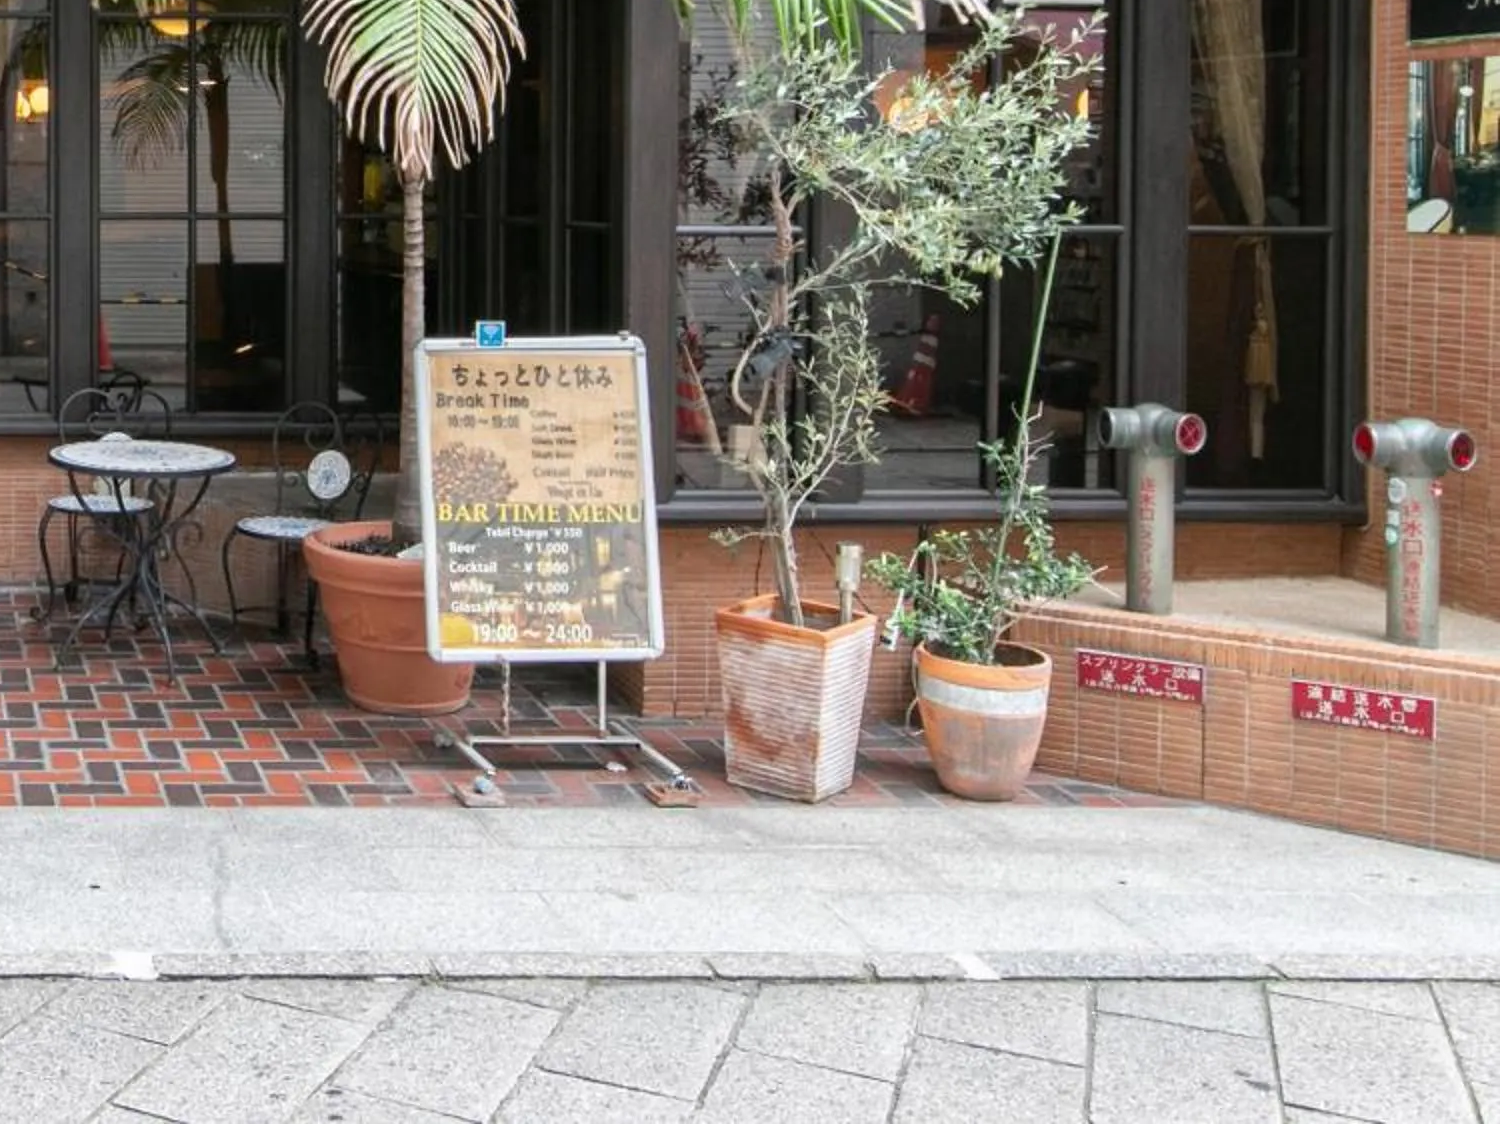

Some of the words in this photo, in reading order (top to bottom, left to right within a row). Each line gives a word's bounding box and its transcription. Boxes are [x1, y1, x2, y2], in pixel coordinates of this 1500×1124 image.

[451, 363, 613, 388] ちょっとひと休み
[436, 392, 485, 409] Break
[490, 393, 530, 409] Time
[438, 502, 490, 523] BAR
[496, 502, 561, 523] TIME
[566, 503, 642, 524] MENU
[449, 541, 477, 554] Beer
[449, 561, 498, 574] Cocktail
